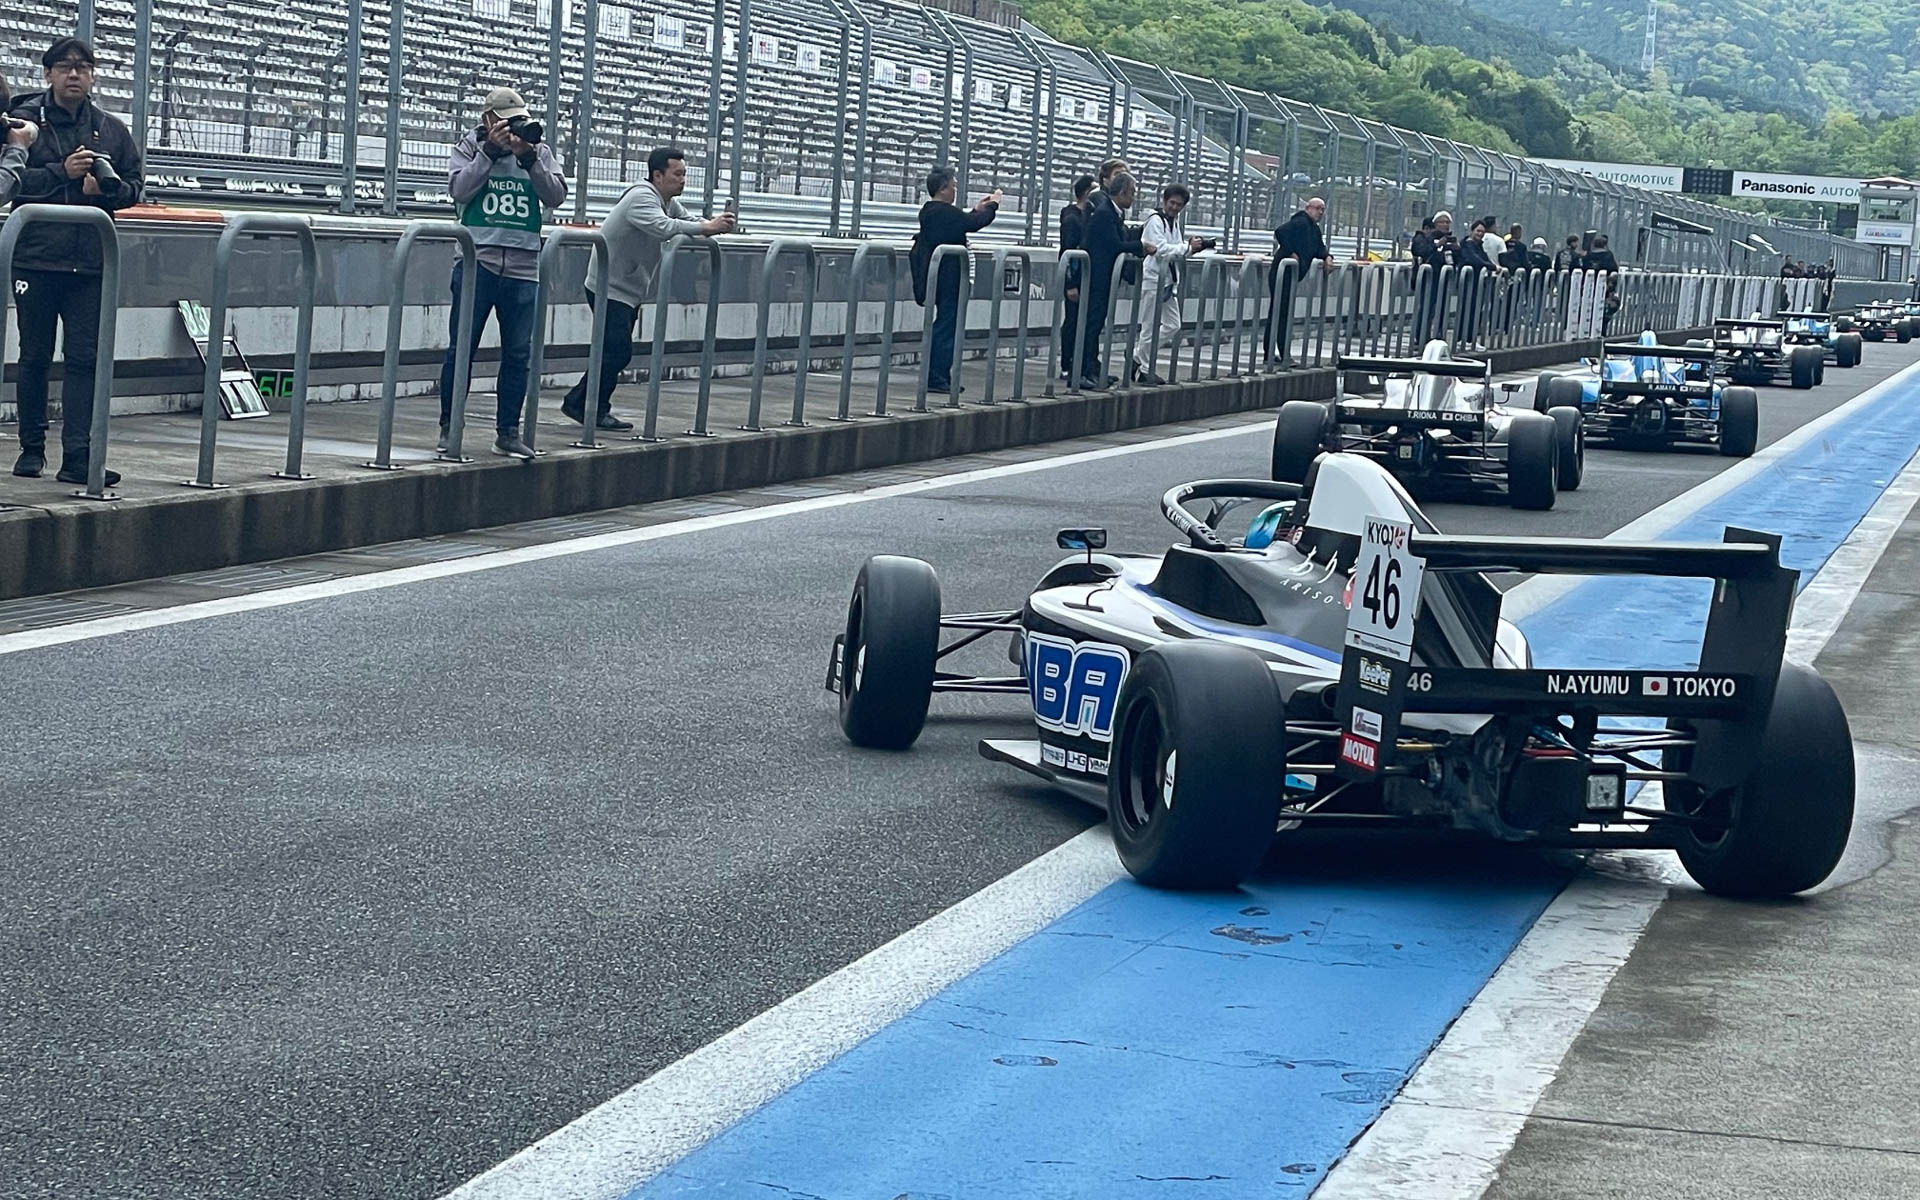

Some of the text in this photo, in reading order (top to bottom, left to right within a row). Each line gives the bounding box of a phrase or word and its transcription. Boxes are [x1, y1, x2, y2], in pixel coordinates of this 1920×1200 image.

[488, 179, 524, 193] MEDIA
[1597, 171, 1675, 186] AUTOMOTIVE
[1741, 179, 1816, 195] Panasonic
[482, 192, 529, 218] 085
[1407, 410, 1437, 420] T.RIONA
[1454, 413, 1478, 422] CHIBA
[1362, 554, 1402, 630] 46
[1406, 672, 1433, 692] 46
[1547, 674, 1630, 695] N.AYUMU
[1673, 677, 1736, 697] TOKYO
[1342, 738, 1375, 767] MOTUL
